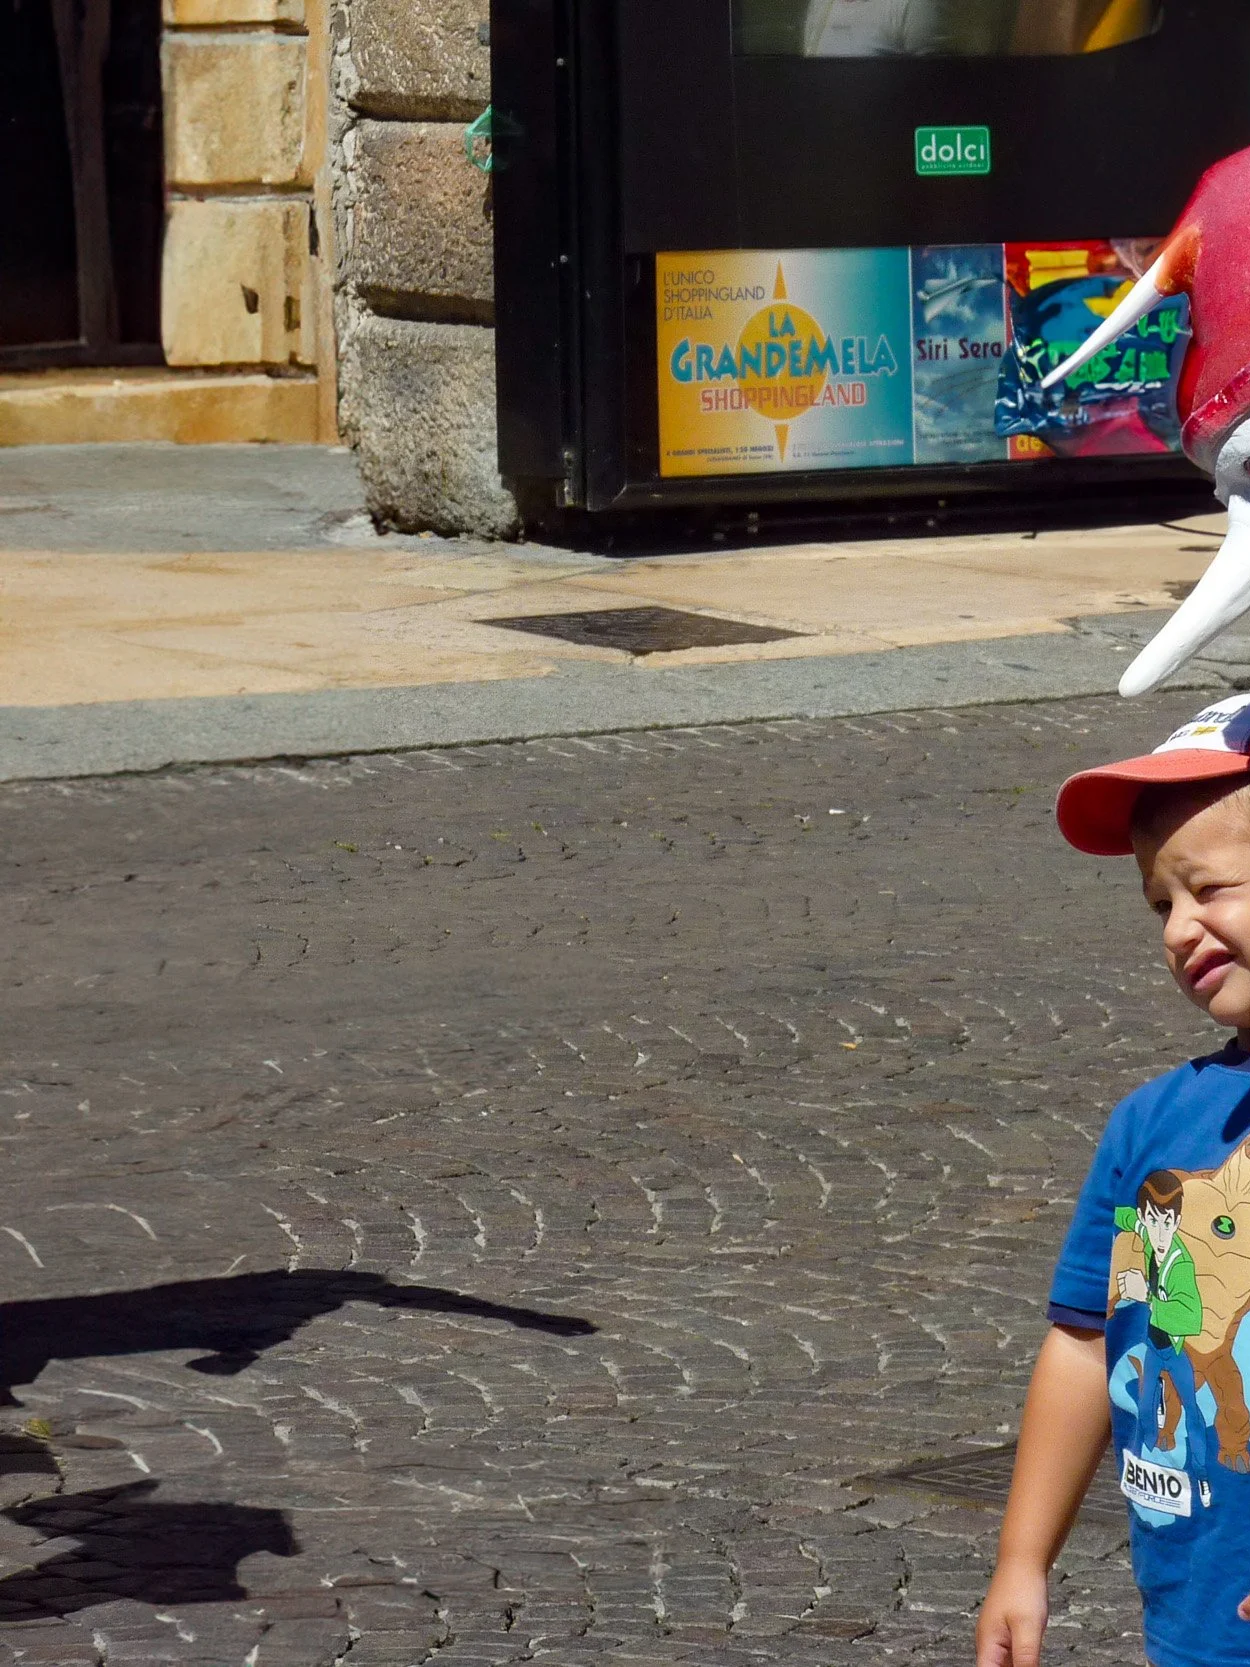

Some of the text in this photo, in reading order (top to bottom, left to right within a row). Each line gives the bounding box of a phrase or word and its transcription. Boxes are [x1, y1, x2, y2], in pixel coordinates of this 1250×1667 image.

[920, 132, 985, 161] dolci
[663, 269, 715, 286] L'UNICO
[663, 285, 766, 304] SHOPPINGLAND
[663, 305, 713, 321] D'ITALIA
[769, 310, 796, 338] LA
[915, 337, 1003, 361] Siri Sera
[701, 381, 867, 412] SHOPPINGLAND
